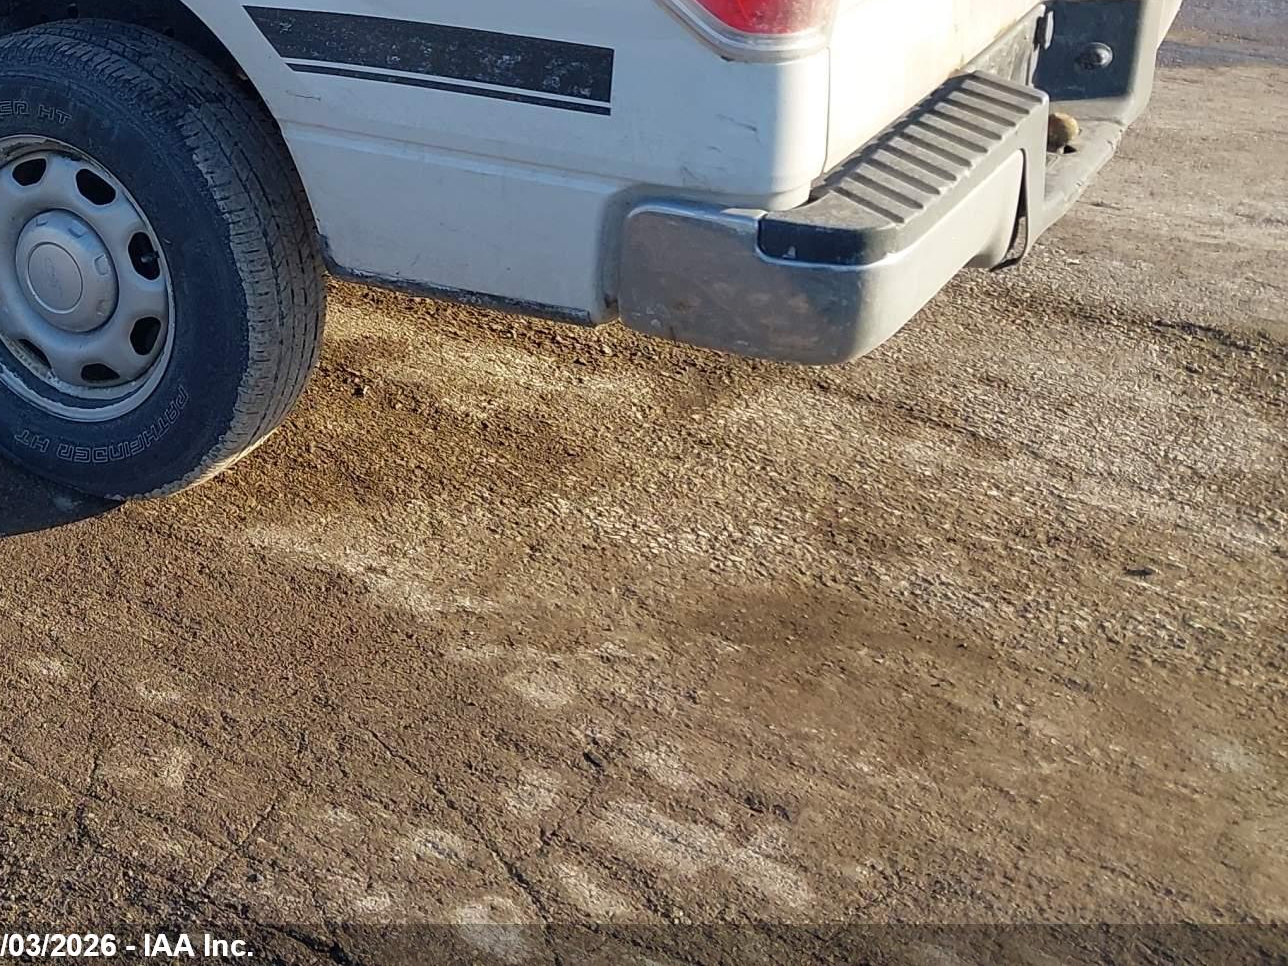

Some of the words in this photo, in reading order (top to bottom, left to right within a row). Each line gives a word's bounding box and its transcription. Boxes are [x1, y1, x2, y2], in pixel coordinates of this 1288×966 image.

[37, 104, 73, 124] HT
[55, 384, 190, 464] PATHFINDER
[14, 429, 50, 453] HT
